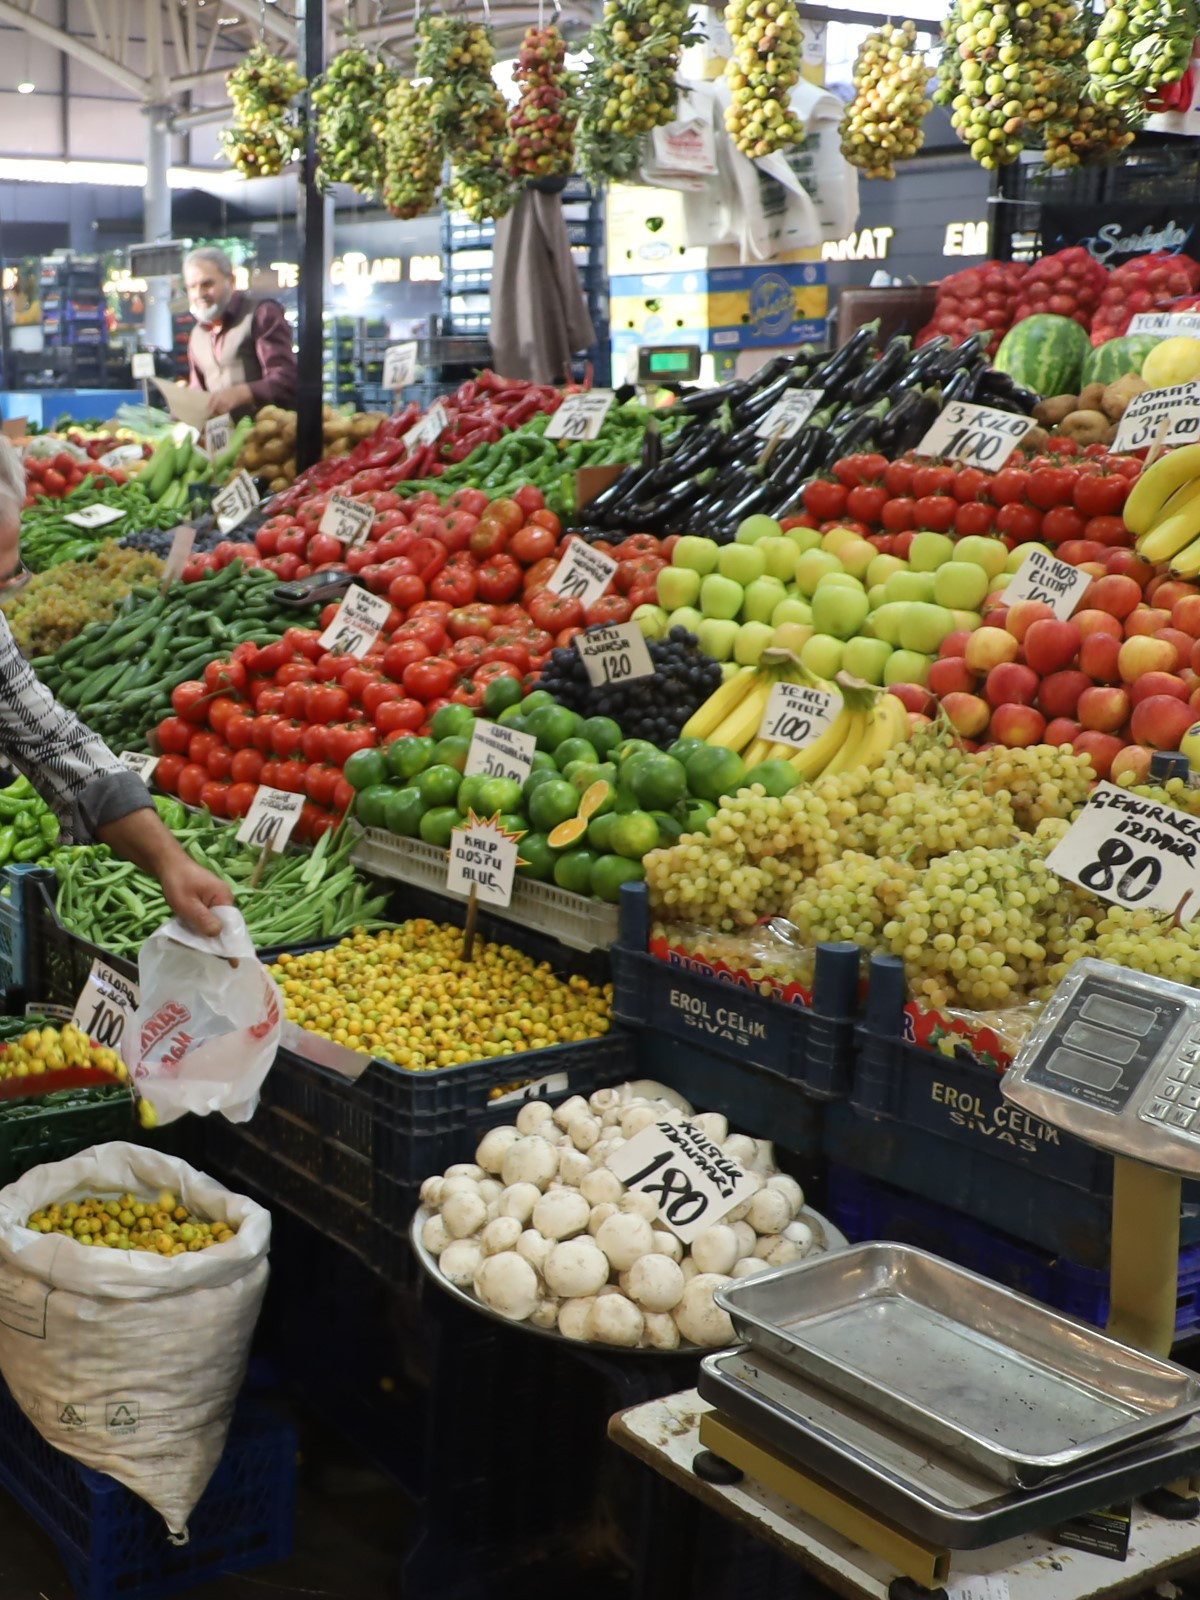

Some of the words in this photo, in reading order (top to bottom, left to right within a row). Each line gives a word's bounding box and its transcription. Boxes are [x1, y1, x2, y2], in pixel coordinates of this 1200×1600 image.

[940, 428, 1002, 460] 100
[602, 653, 631, 682] 120
[769, 712, 811, 741] 100
[456, 848, 502, 871] DOSTU
[464, 835, 498, 853] KALP
[1078, 838, 1162, 902] 80
[670, 989, 711, 1019] EROL
[86, 1000, 125, 1048] 100
[931, 1081, 986, 1119] EROL
[623, 1150, 709, 1226] 180
